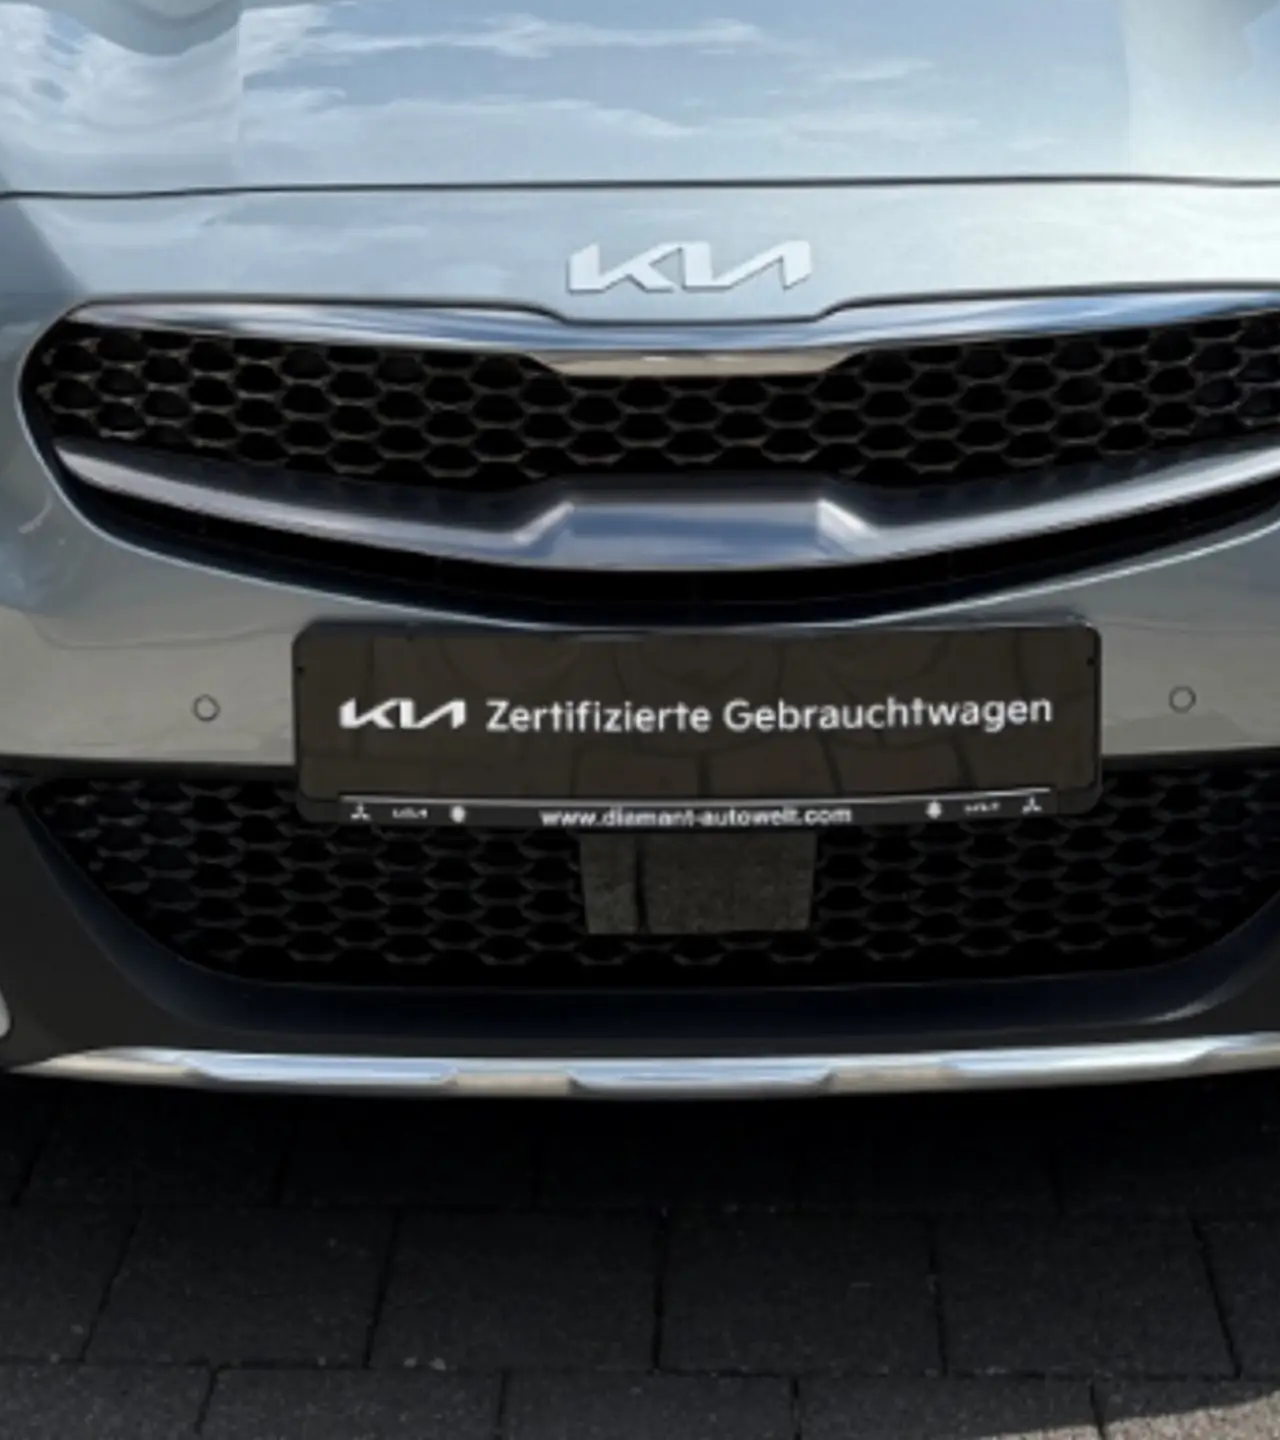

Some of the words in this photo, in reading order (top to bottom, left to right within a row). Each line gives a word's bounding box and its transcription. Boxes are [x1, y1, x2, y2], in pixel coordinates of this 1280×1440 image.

[567, 239, 813, 294] KIA
[338, 697, 467, 730] KIA
[485, 698, 713, 734] Zertifizierte
[722, 695, 1053, 734] Gebrauchtwagen
[539, 806, 853, 828] www.diamant-autowelt.com
